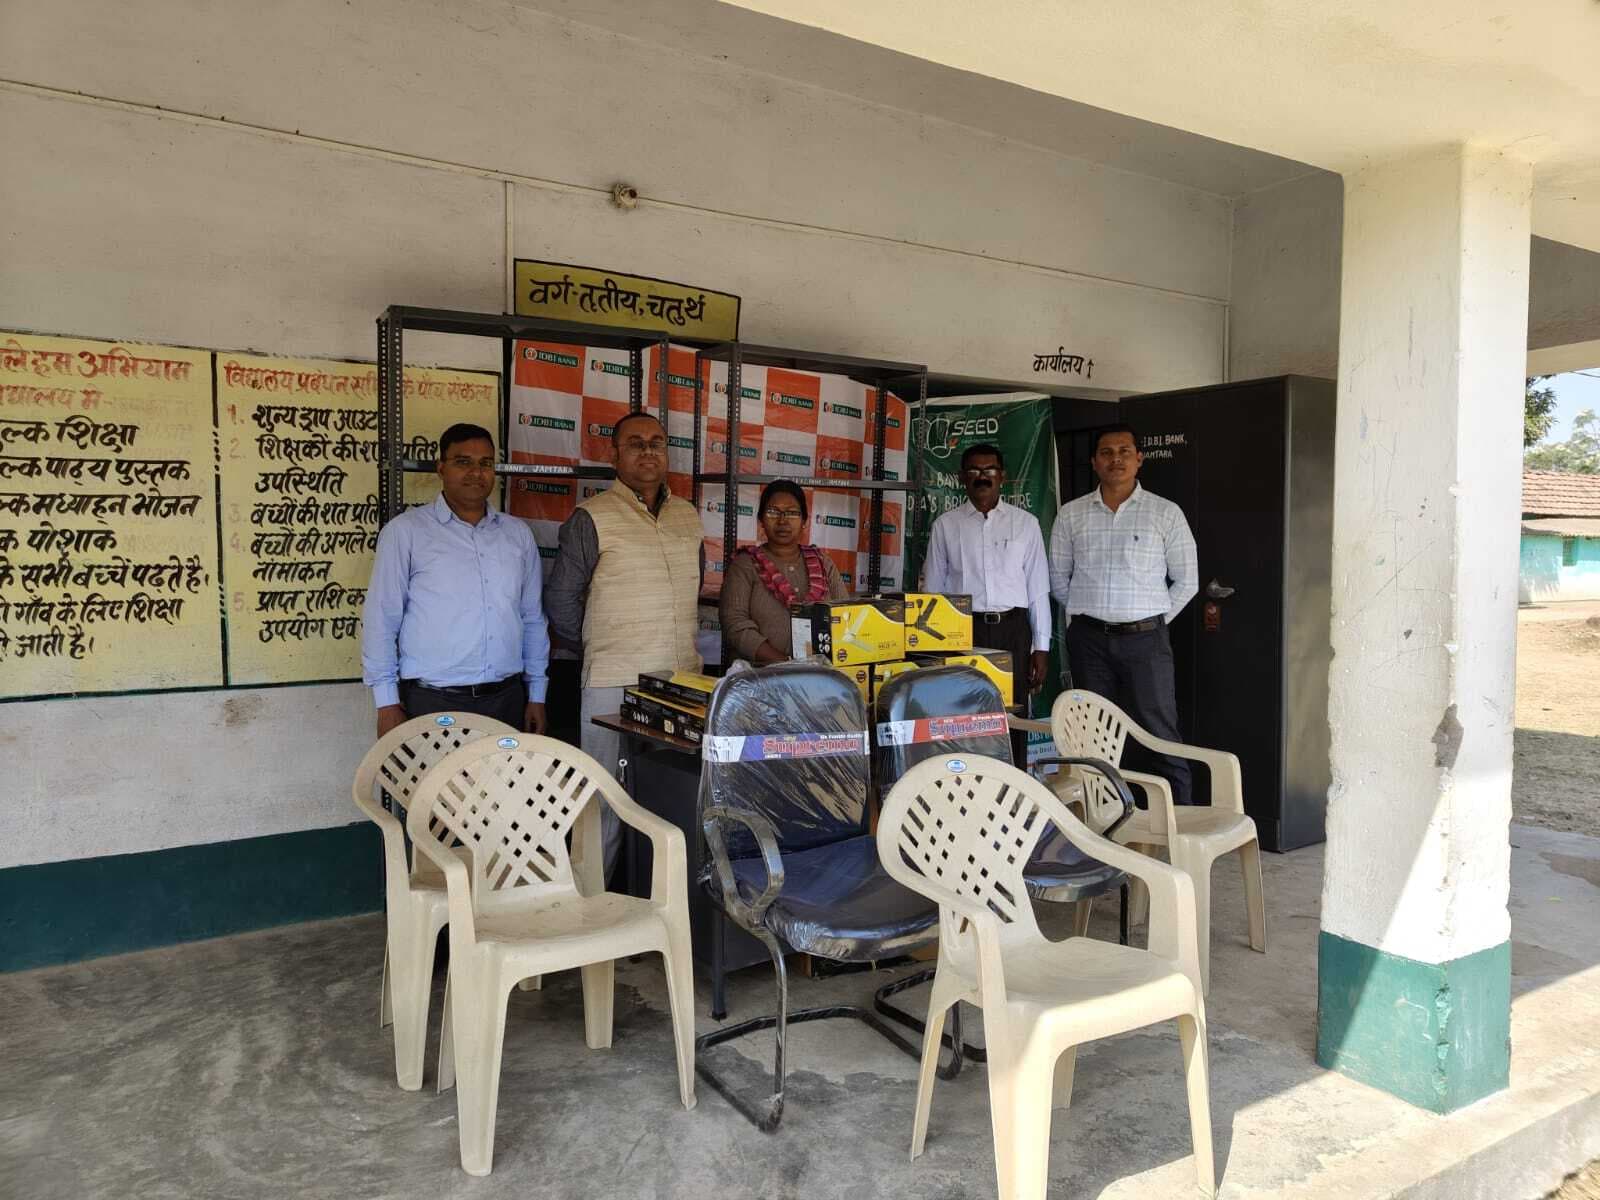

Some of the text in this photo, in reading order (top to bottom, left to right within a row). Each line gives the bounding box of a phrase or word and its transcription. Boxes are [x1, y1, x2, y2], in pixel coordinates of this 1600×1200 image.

[1033, 346, 1085, 375] कार्यालय
[0, 415, 140, 453] ल्क शिक्षा
[951, 417, 999, 435] SEED
[255, 433, 332, 465] शिक्षकों
[115, 458, 191, 486] पुस्तक
[254, 465, 347, 496] उपस्थिति
[936, 472, 967, 489] BAN
[131, 488, 203, 518] भोजन
[27, 521, 118, 553] पोशाक
[296, 528, 321, 556] की
[56, 593, 79, 624] के
[124, 591, 184, 625] शिक्षा
[15, 624, 65, 657] जाती
[258, 611, 328, 643] उपयोग
